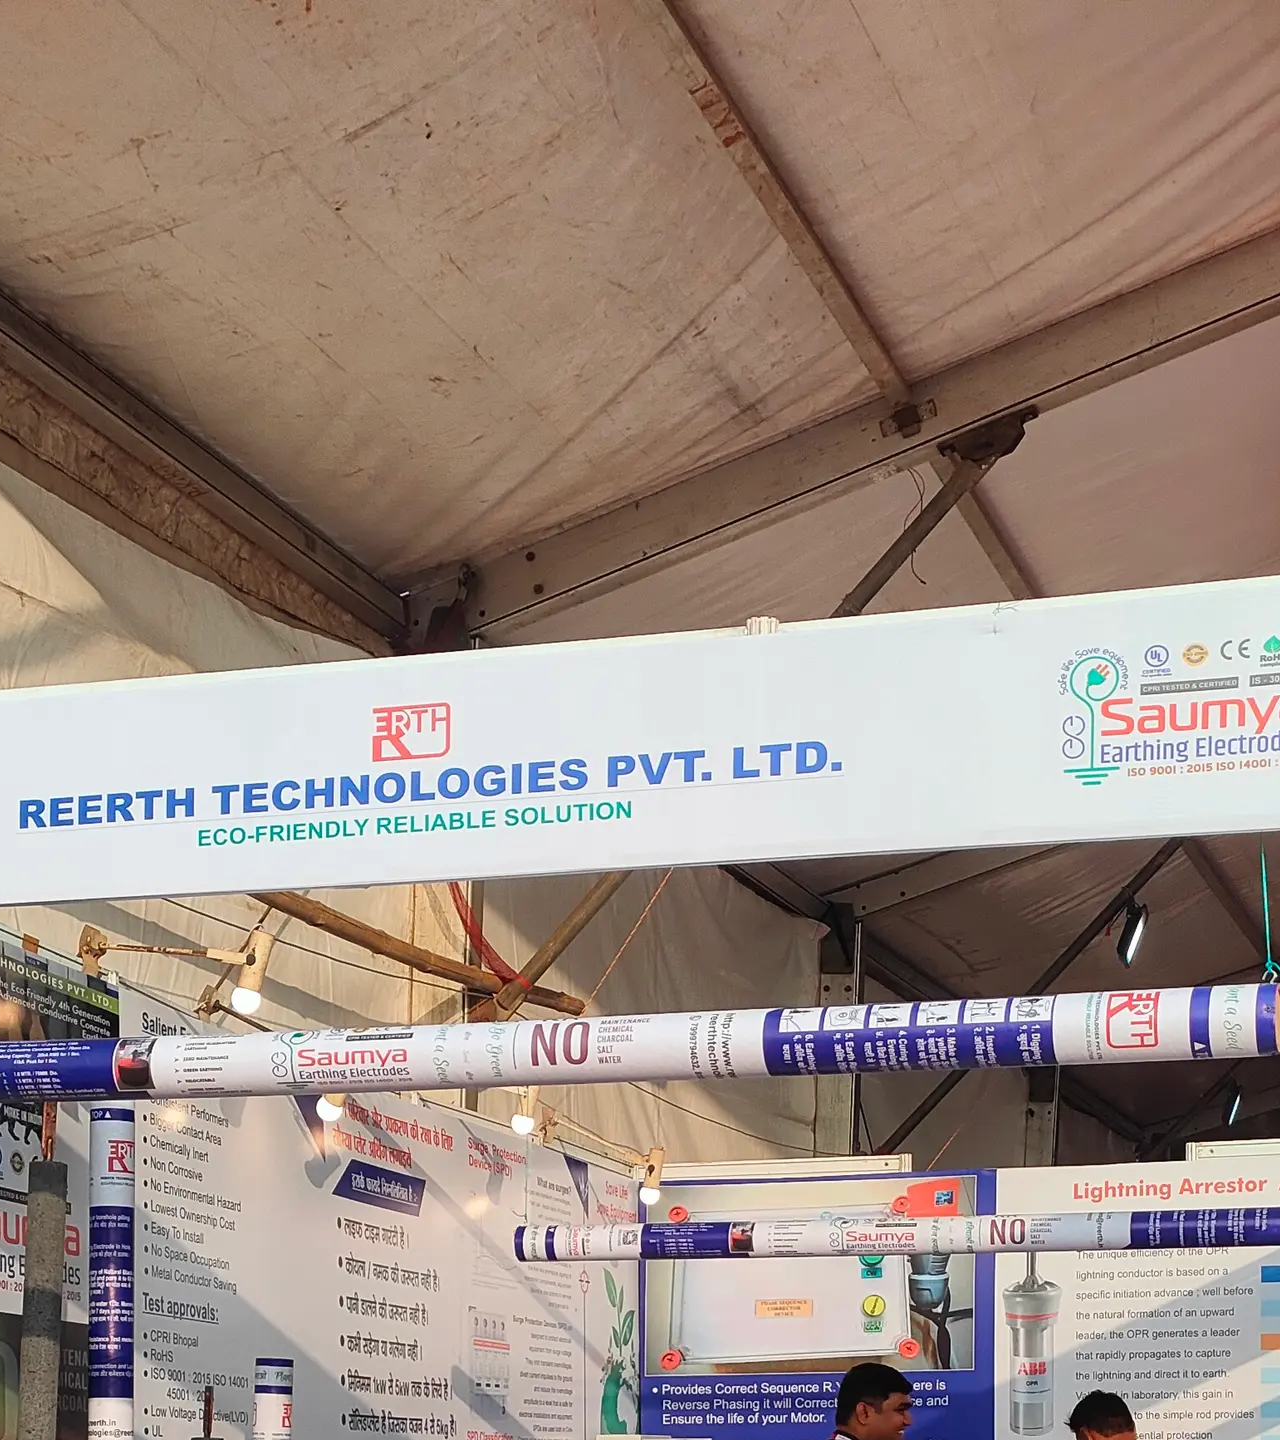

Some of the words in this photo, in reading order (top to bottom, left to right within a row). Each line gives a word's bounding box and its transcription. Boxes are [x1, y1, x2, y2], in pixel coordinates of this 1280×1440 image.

[1142, 684, 1161, 693] CPRI
[1163, 681, 1190, 691] TESTED
[1199, 678, 1237, 689] CERTIFIED
[1100, 738, 1189, 764] Earthing
[19, 788, 196, 829] REERTH
[212, 758, 589, 816] TECHNOLOGIES
[607, 749, 712, 788] PVT.
[733, 741, 843, 779] LTD.
[197, 817, 369, 847] ECO-FRIENDLY
[376, 809, 496, 835] RELIABLE
[504, 801, 632, 827] SOLUTION
[67, 983, 89, 998] PVT.
[92, 991, 112, 1009] LTD.
[38, 1003, 78, 1026] Conductive
[79, 1017, 111, 1038] Concrete
[58, 998, 70, 1012] 4th
[71, 1004, 111, 1027] Generation
[597, 1034, 634, 1043] CHARCOAL
[598, 1025, 634, 1033] CHEMICAL
[530, 1020, 590, 1068] NO
[597, 1045, 613, 1054] SALT
[598, 1055, 622, 1064] WATER
[150, 1135, 191, 1160] Chemically
[193, 1150, 209, 1163] Inert
[468, 1137, 488, 1157] Surge
[492, 1144, 526, 1165] Protection
[150, 1157, 166, 1174] Non
[168, 1164, 203, 1182] Corrosive
[468, 1154, 492, 1172] Device
[493, 1162, 512, 1182] (SPD)
[150, 1179, 162, 1193] No
[164, 1181, 215, 1206] Environmental
[216, 1195, 242, 1213] Hazard
[1072, 1180, 1173, 1204] Lightning
[1178, 1175, 1269, 1196] Arrestor
[150, 1201, 178, 1219] Lowest
[179, 1208, 218, 1229] Ownership
[220, 1219, 236, 1232] Cost
[151, 1243, 162, 1257] No
[164, 1247, 188, 1264] Space
[190, 1252, 230, 1271] Occupation
[152, 1266, 172, 1281] Metal
[174, 1270, 212, 1288] Conductor
[213, 1279, 237, 1295] Saving
[1075, 1268, 1113, 1282] lightning
[1116, 1266, 1164, 1279] conductor
[1166, 1266, 1173, 1278] is
[1176, 1266, 1205, 1278] based
[1207, 1268, 1219, 1278] on
[143, 1292, 164, 1313] Test
[167, 1299, 220, 1321] approvals:
[150, 1329, 171, 1343] CPRI
[173, 1334, 199, 1349] Bhopal
[150, 1349, 174, 1362] RoHS
[662, 1383, 712, 1396] Provides
[714, 1381, 758, 1395] Correct
[760, 1381, 819, 1396] Sequence
[662, 1412, 703, 1425] Ensure
[706, 1412, 724, 1425] the
[728, 1412, 745, 1424] life
[747, 1411, 759, 1424] of
[761, 1412, 787, 1428] your
[789, 1412, 827, 1424] Motor.
